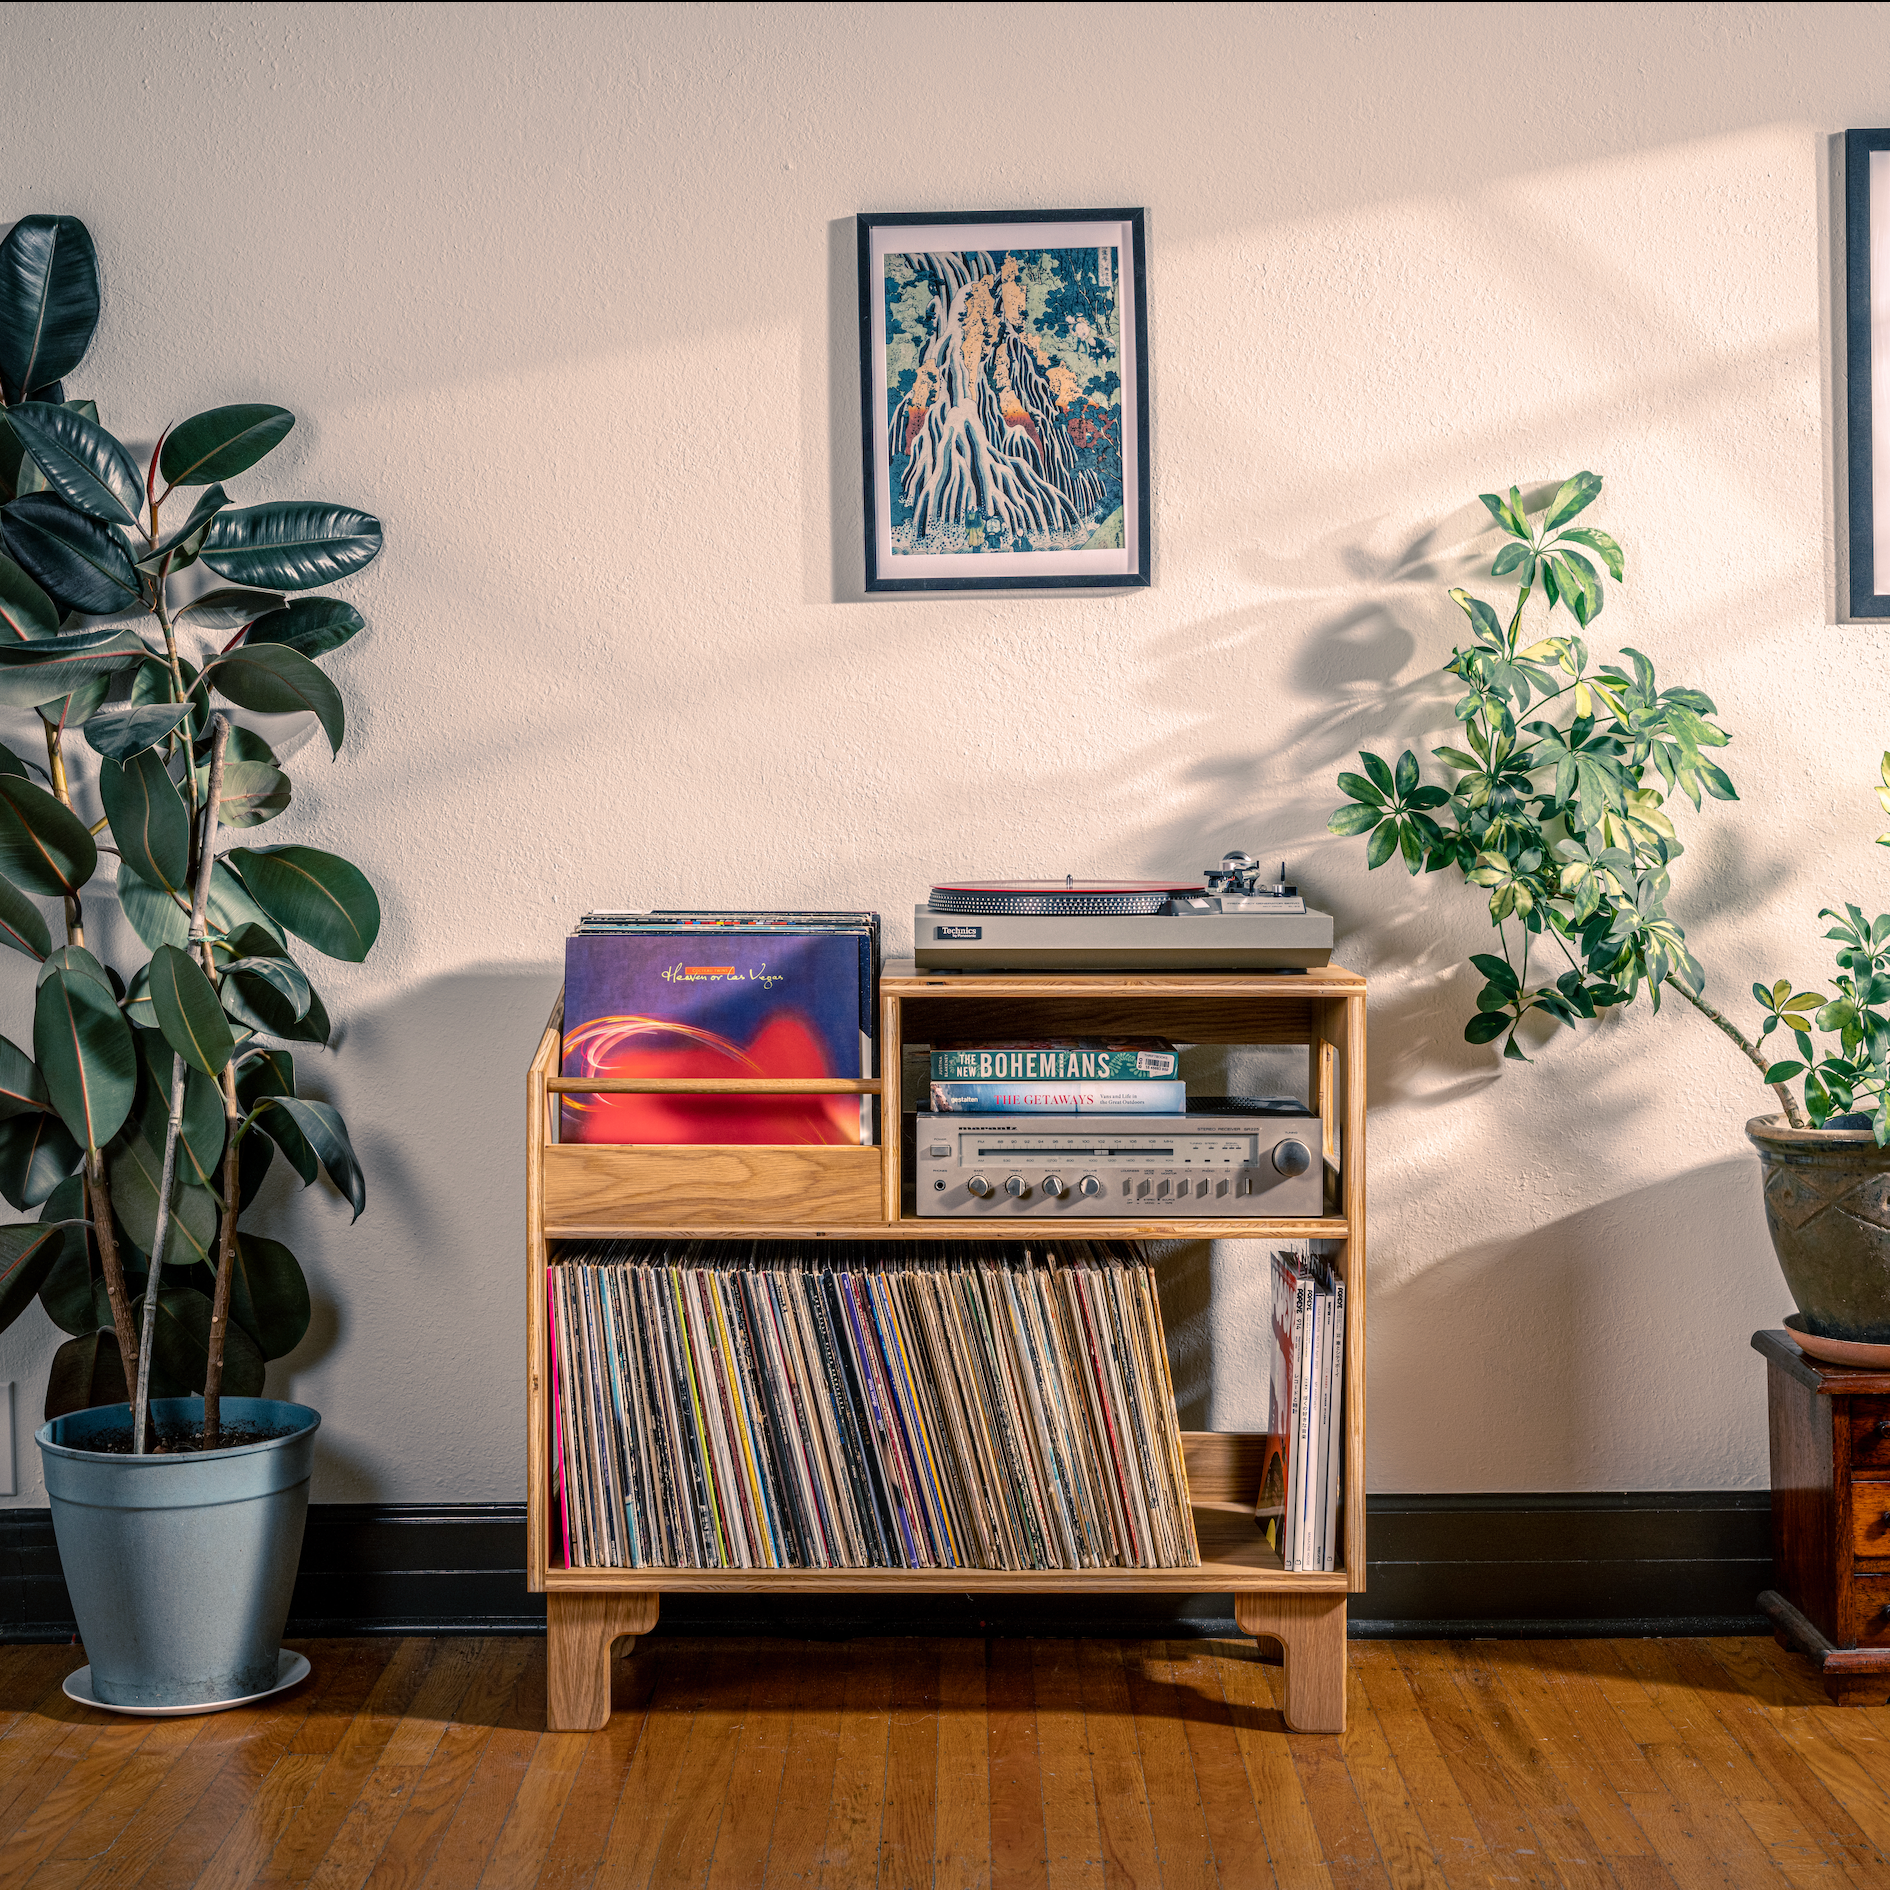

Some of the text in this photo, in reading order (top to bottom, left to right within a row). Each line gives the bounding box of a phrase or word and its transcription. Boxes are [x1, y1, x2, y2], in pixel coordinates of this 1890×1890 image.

[942, 926, 976, 934] Technics
[661, 962, 708, 983] Heaven
[749, 962, 784, 990] Vegas
[960, 1054, 976, 1065] THE
[980, 1053, 1110, 1078] BOHEMIANS
[957, 1066, 976, 1077] NEW
[993, 1095, 1094, 1105] THE GETAWAYS
[858, 1412, 870, 1444] MIRRORS
